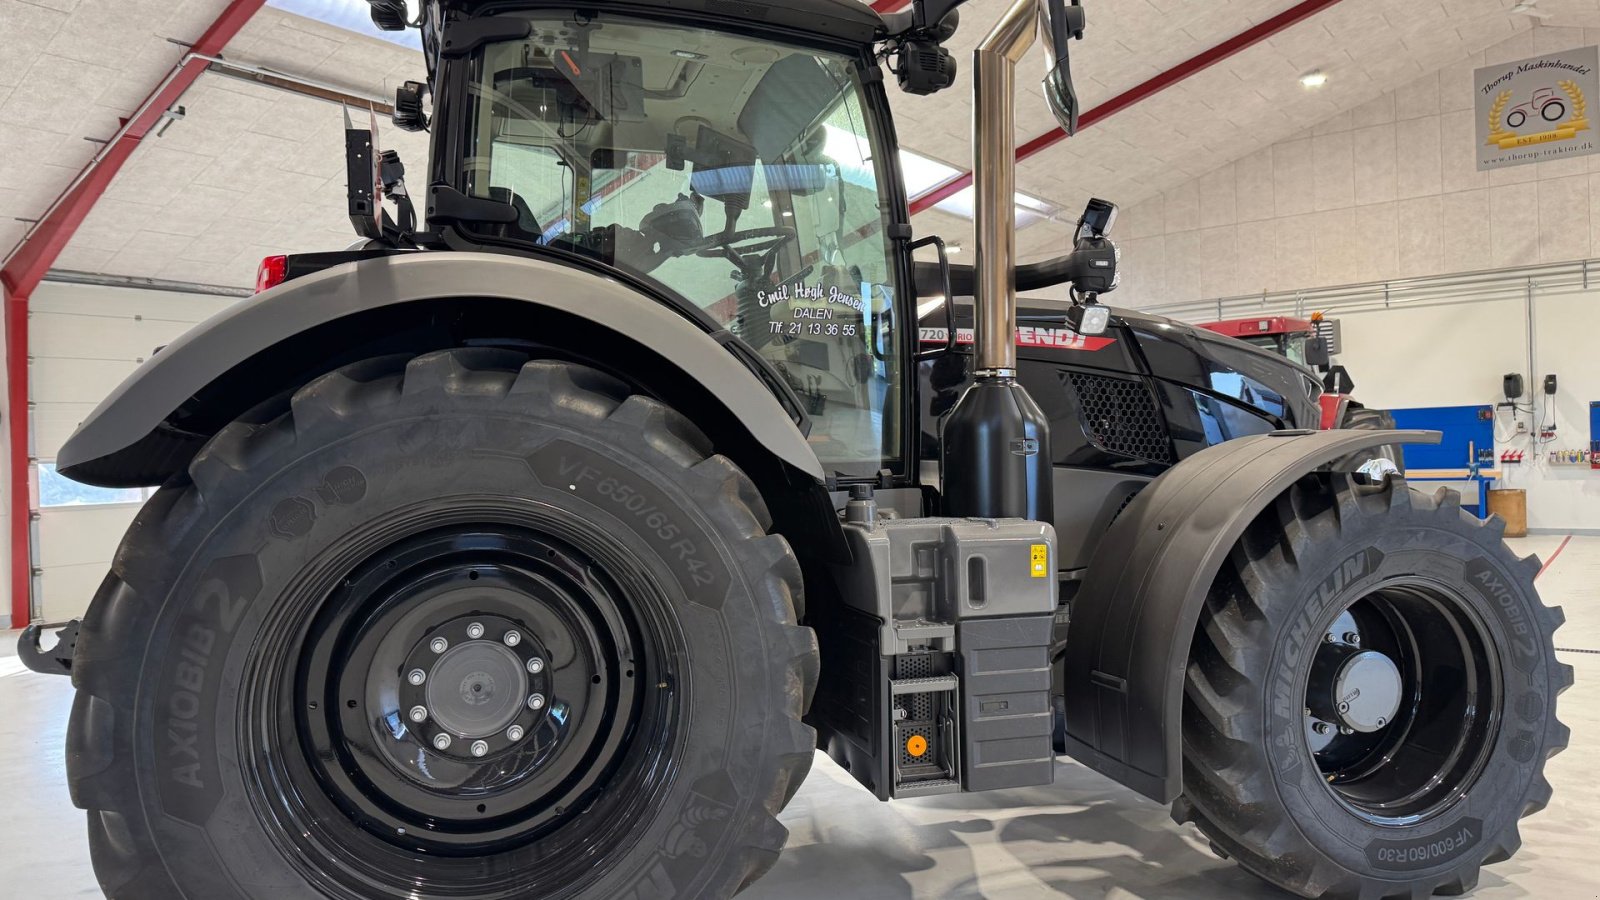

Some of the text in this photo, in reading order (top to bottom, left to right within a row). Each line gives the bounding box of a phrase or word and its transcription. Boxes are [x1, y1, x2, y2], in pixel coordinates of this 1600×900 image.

[1481, 59, 1591, 95] Thorup Maskinhandel
[1483, 141, 1593, 165] www.thorup-traktor.dk
[757, 281, 865, 312] Emil Høgh Jensen
[793, 307, 833, 320] DALEN
[768, 321, 856, 336] Tlf. 21 13 36 55
[920, 329, 944, 340] 720
[1015, 325, 1086, 348] ENDT
[558, 456, 715, 588] VF 650/65 R42
[1474, 570, 1528, 635] AXIOBIB
[1513, 637, 1537, 658] 2
[1273, 549, 1366, 720] MICHELIN
[167, 577, 248, 790] AXIOBIB 2
[1455, 826, 1473, 848] VF
